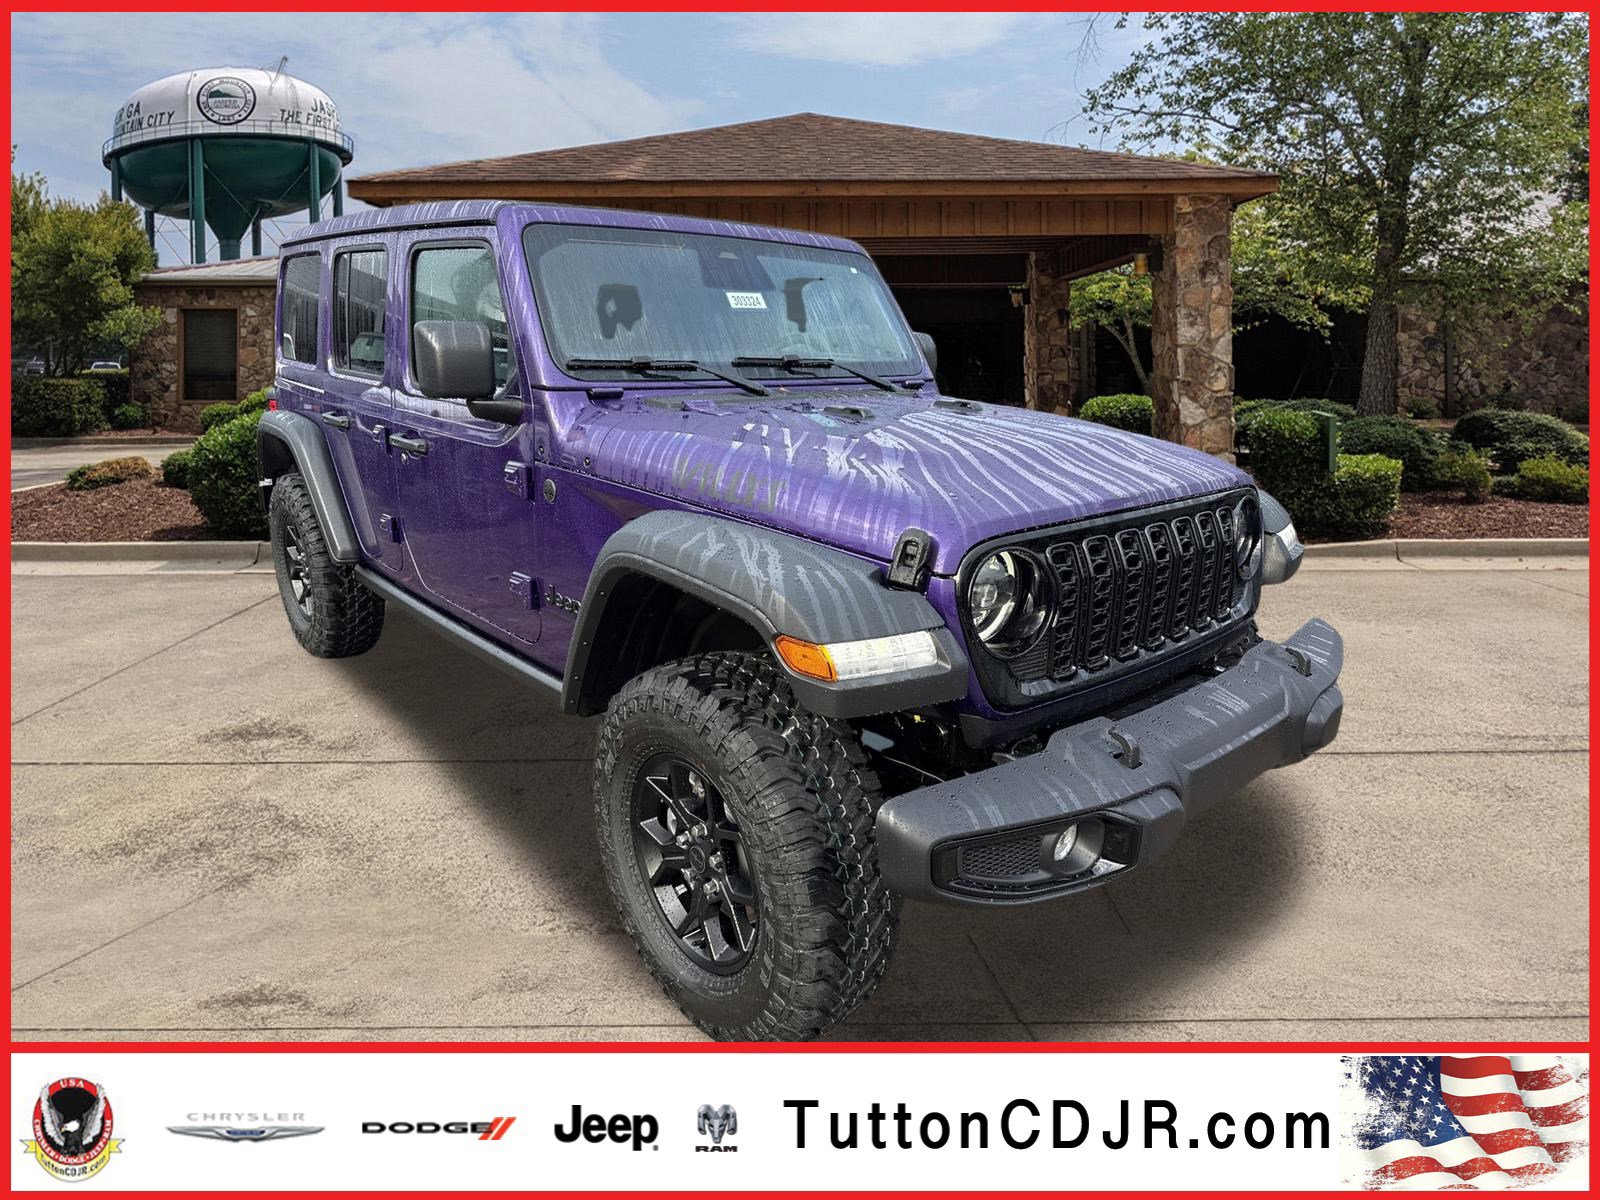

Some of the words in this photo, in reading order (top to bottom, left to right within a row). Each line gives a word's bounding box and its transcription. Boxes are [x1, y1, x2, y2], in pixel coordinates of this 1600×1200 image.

[126, 101, 141, 119] GA
[147, 110, 175, 127] CITY
[280, 109, 302, 123] THE
[306, 112, 332, 129] FIRST
[731, 295, 762, 306] 303324
[544, 584, 581, 614] Jeep
